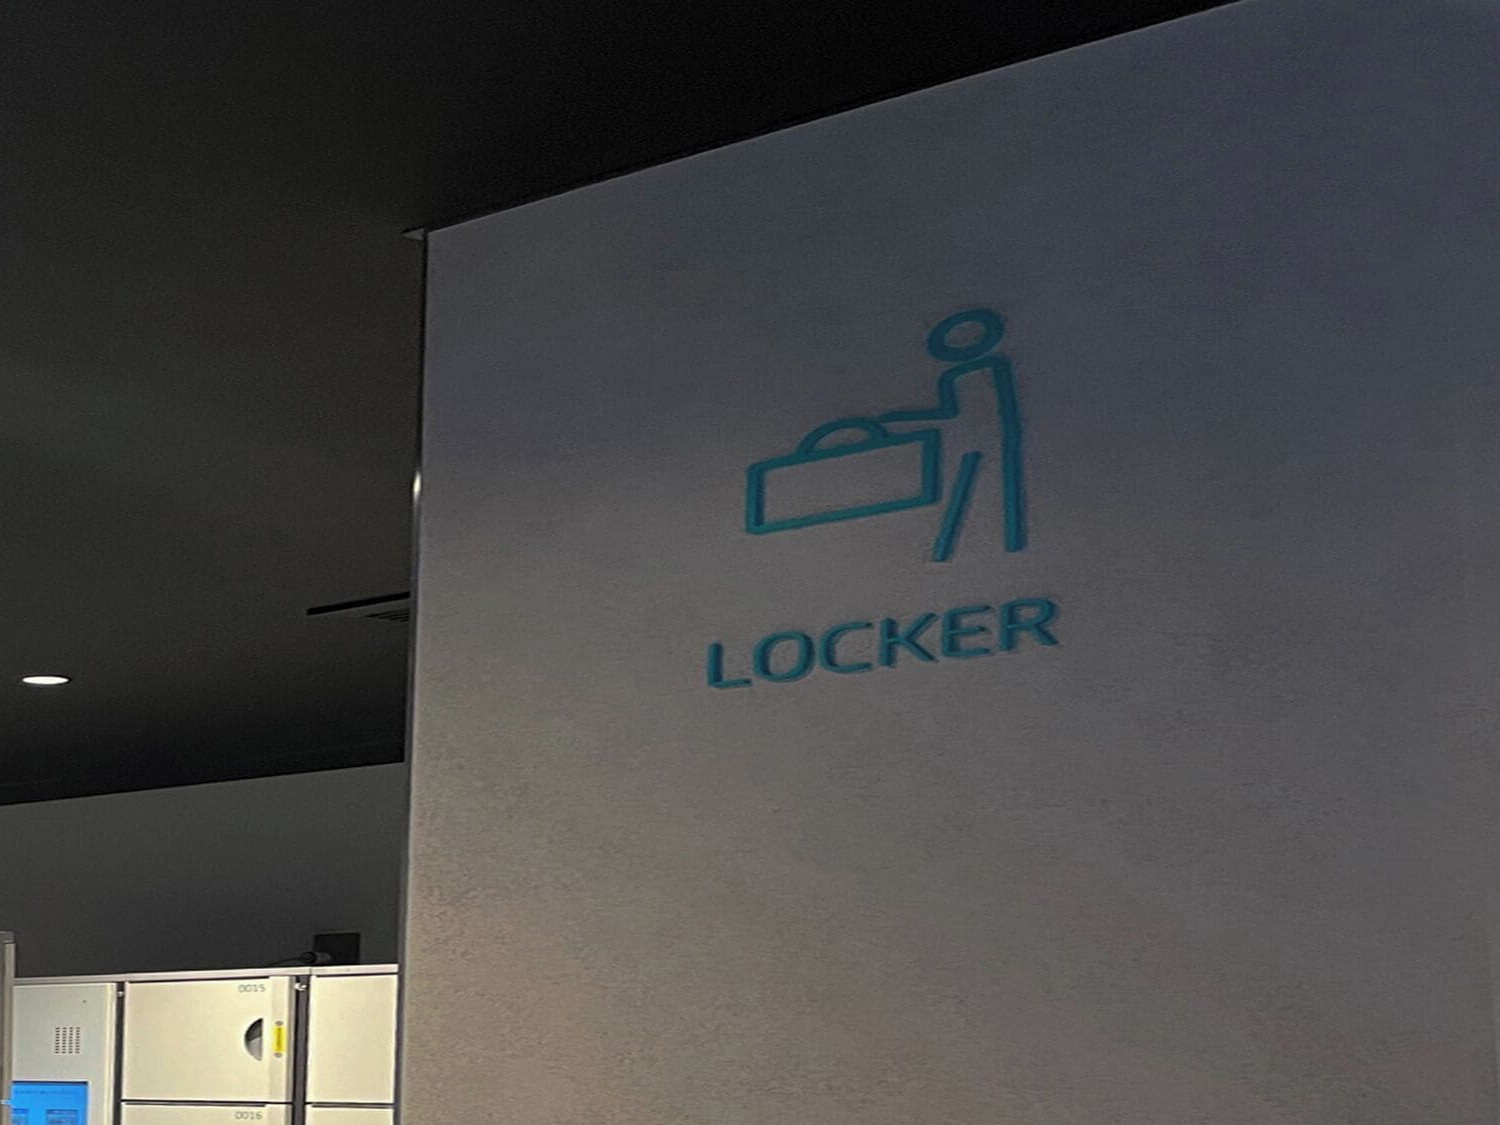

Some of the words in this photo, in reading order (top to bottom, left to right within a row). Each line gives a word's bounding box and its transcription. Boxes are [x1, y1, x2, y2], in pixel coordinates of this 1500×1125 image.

[707, 597, 1060, 689] LOCKER
[238, 983, 266, 993] 0015
[235, 1110, 263, 1120] 0016
